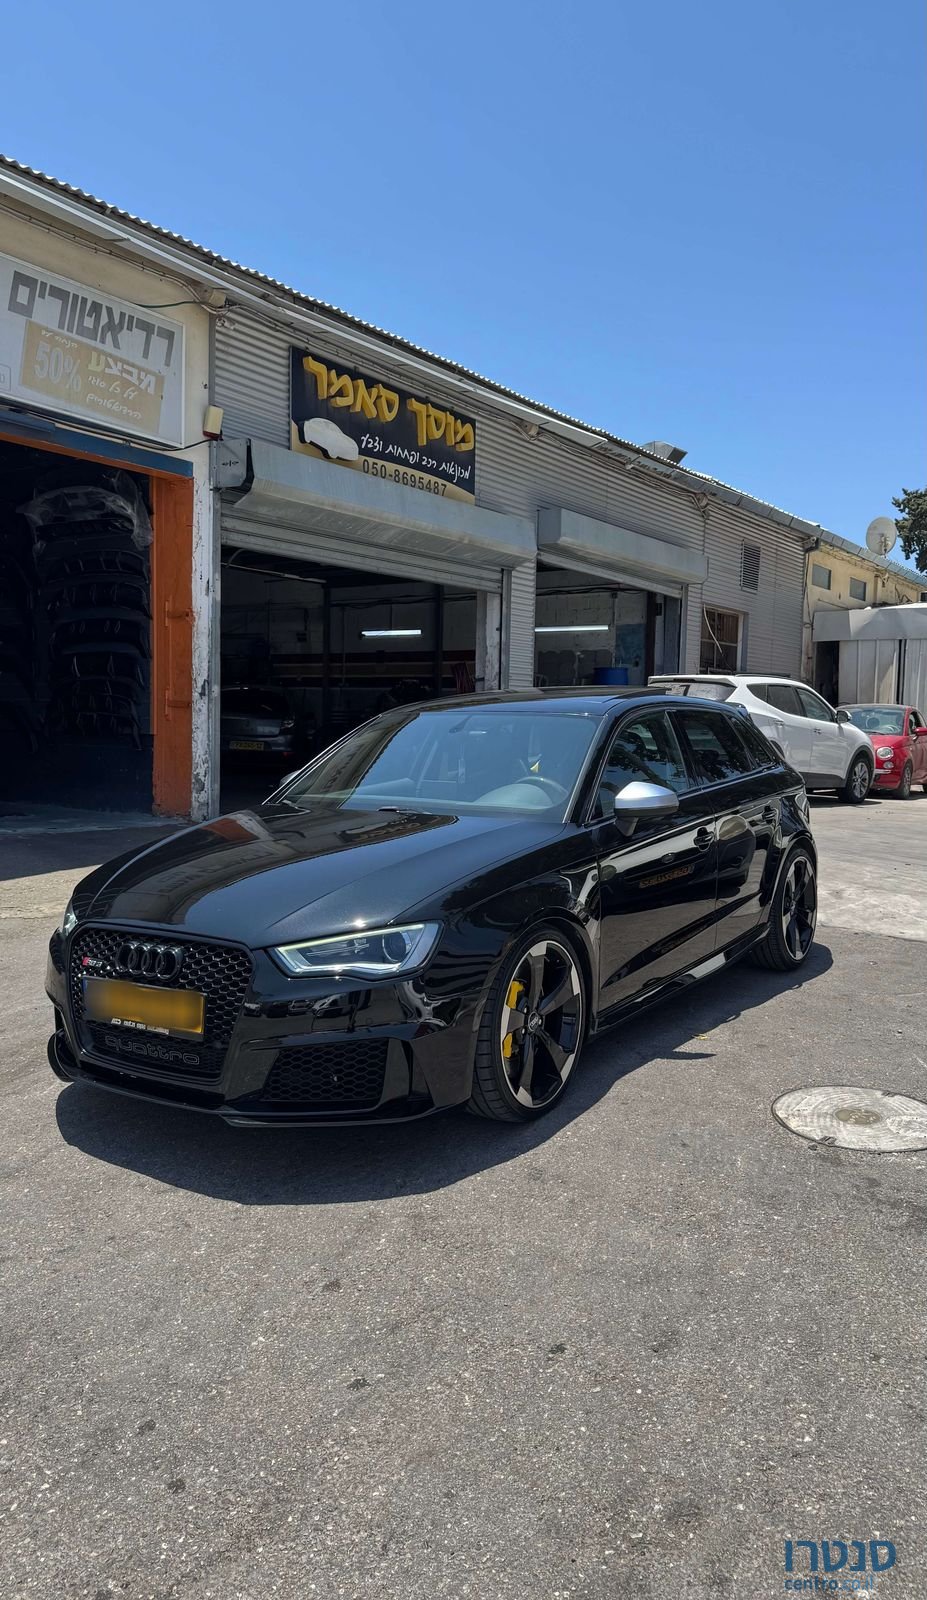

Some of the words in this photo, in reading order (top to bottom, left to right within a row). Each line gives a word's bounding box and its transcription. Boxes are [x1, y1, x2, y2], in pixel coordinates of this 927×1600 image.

[7, 270, 176, 367] רדיאטורים
[33, 340, 82, 392] 50%
[88, 351, 156, 395] מבצע
[303, 356, 400, 423] סאמר
[360, 433, 383, 452] וצבע
[407, 398, 475, 452] מוסך
[385, 444, 420, 464] ופחחות
[421, 456, 437, 468] רכב
[362, 458, 447, 497] 050-8695487
[104, 1034, 200, 1065] quattro
